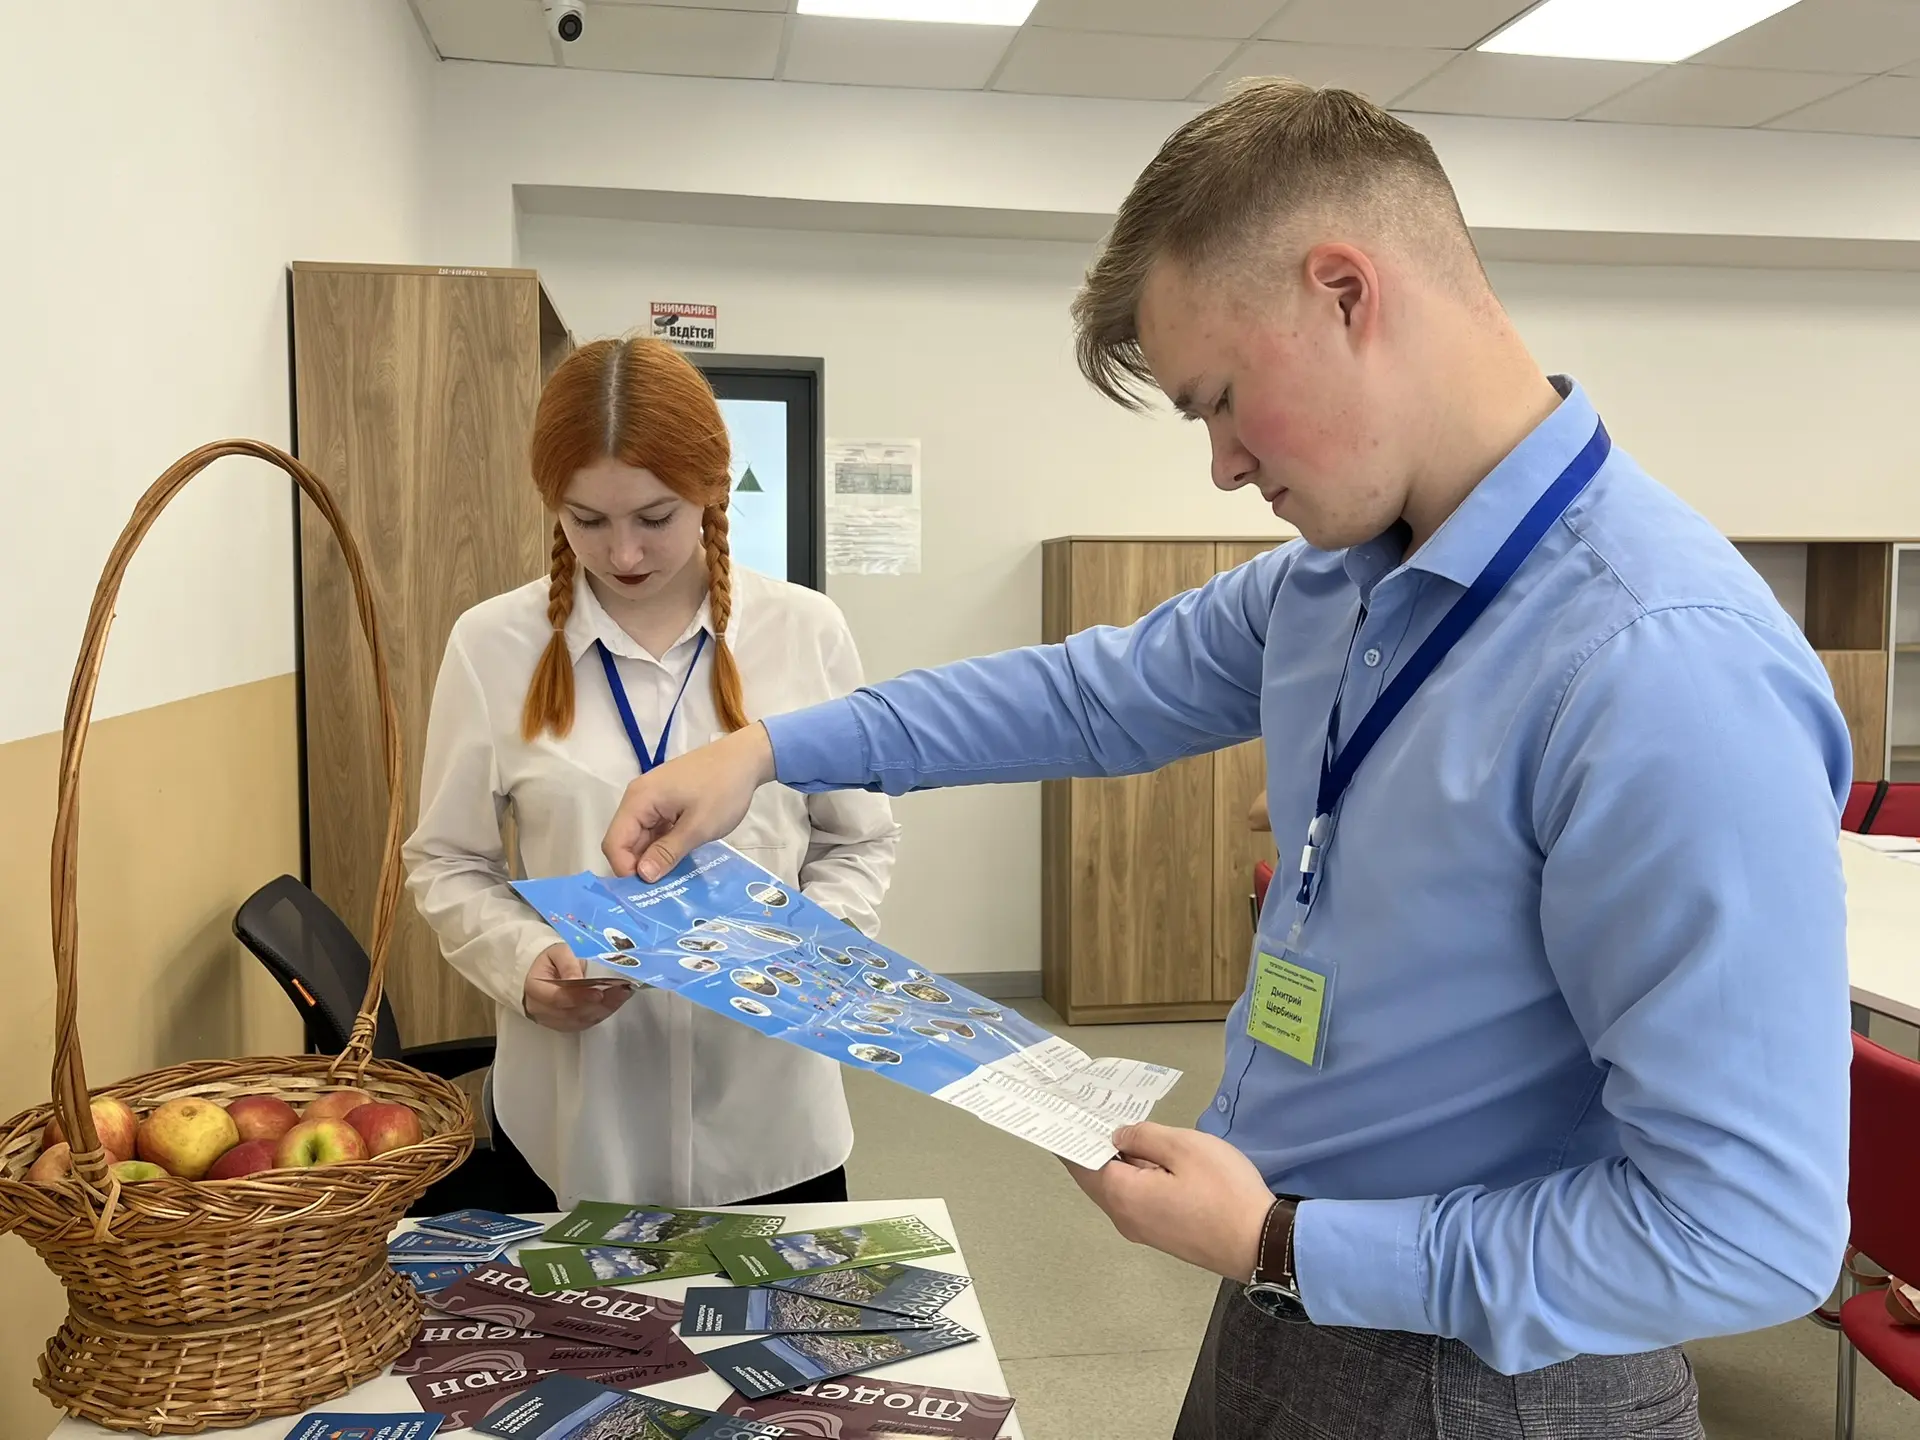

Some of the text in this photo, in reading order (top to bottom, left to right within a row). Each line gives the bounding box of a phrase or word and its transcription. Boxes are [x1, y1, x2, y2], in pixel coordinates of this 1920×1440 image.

[653, 303, 715, 316] ВНИМАНИЕ!
[670, 325, 714, 339] ВЕДЁТСЯ
[1270, 986, 1302, 1006] Дмитрий
[1266, 1000, 1302, 1023] Щербинин
[757, 1218, 783, 1236] БОВ
[909, 1276, 972, 1318] ТАМБОВ
[499, 1402, 544, 1433] ТАМБОВСКОЙ
[508, 1412, 541, 1435] ОБЛАСТИ
[300, 1419, 322, 1440] БОВСКАЯ
